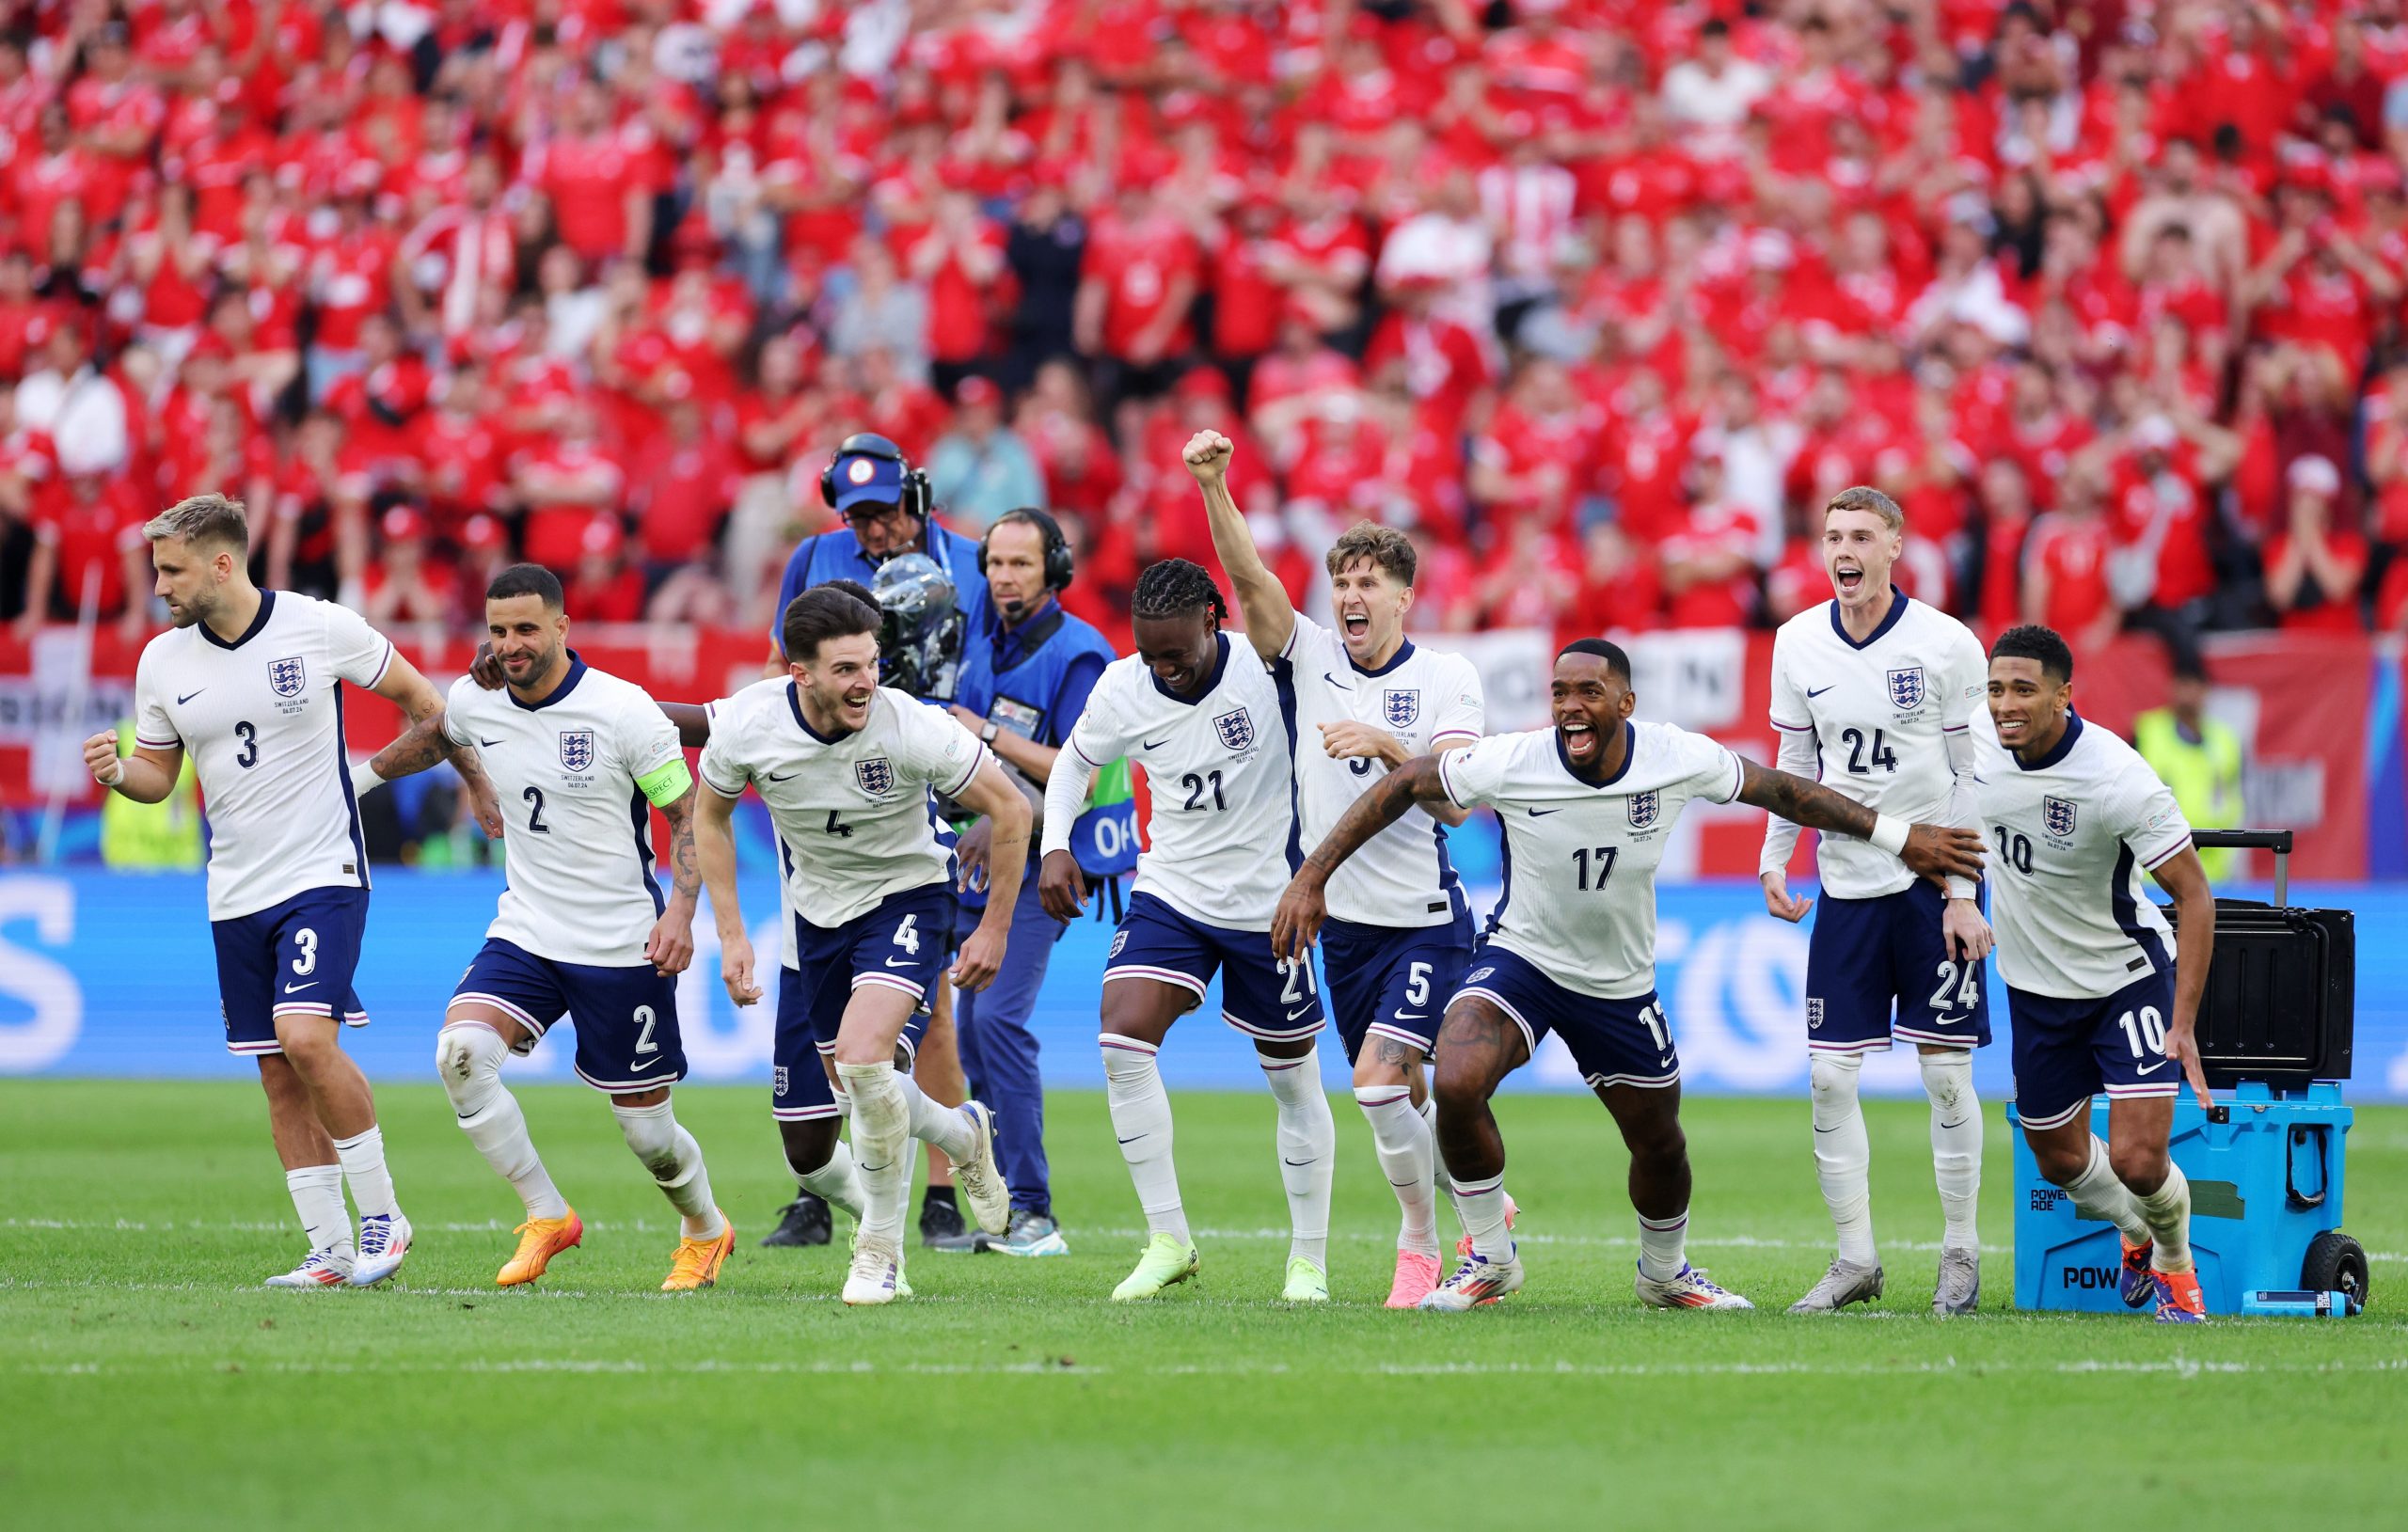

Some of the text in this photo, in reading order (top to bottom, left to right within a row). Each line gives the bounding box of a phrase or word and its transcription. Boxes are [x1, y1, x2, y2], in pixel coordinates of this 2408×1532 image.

[274, 698, 309, 708] SWITZERLAND
[1893, 709, 1925, 719] SWITZERLAND
[234, 720, 259, 769] 3
[1228, 747, 1259, 761] SWITZERLAND
[1842, 728, 1898, 774] 24
[645, 777, 673, 798] ESPECT
[1181, 769, 1227, 812] 21
[523, 786, 549, 834] 2
[826, 810, 853, 837] 4
[1626, 828, 1659, 838] SWITZERLAND
[1994, 826, 2034, 877] 10
[2041, 832, 2074, 847] SWITZERLAND
[1572, 846, 1618, 891] 17
[292, 927, 318, 976] 3
[893, 913, 920, 955] 4
[1276, 946, 1317, 1004] 21
[1405, 961, 1434, 1007] 5
[1929, 960, 1979, 1011] 24
[633, 1004, 658, 1054] 2
[2118, 1005, 2167, 1058] 10
[2031, 1200, 2054, 1211] ADE
[2063, 1267, 2120, 1289] POW
[2322, 1290, 2331, 1308] OWER
